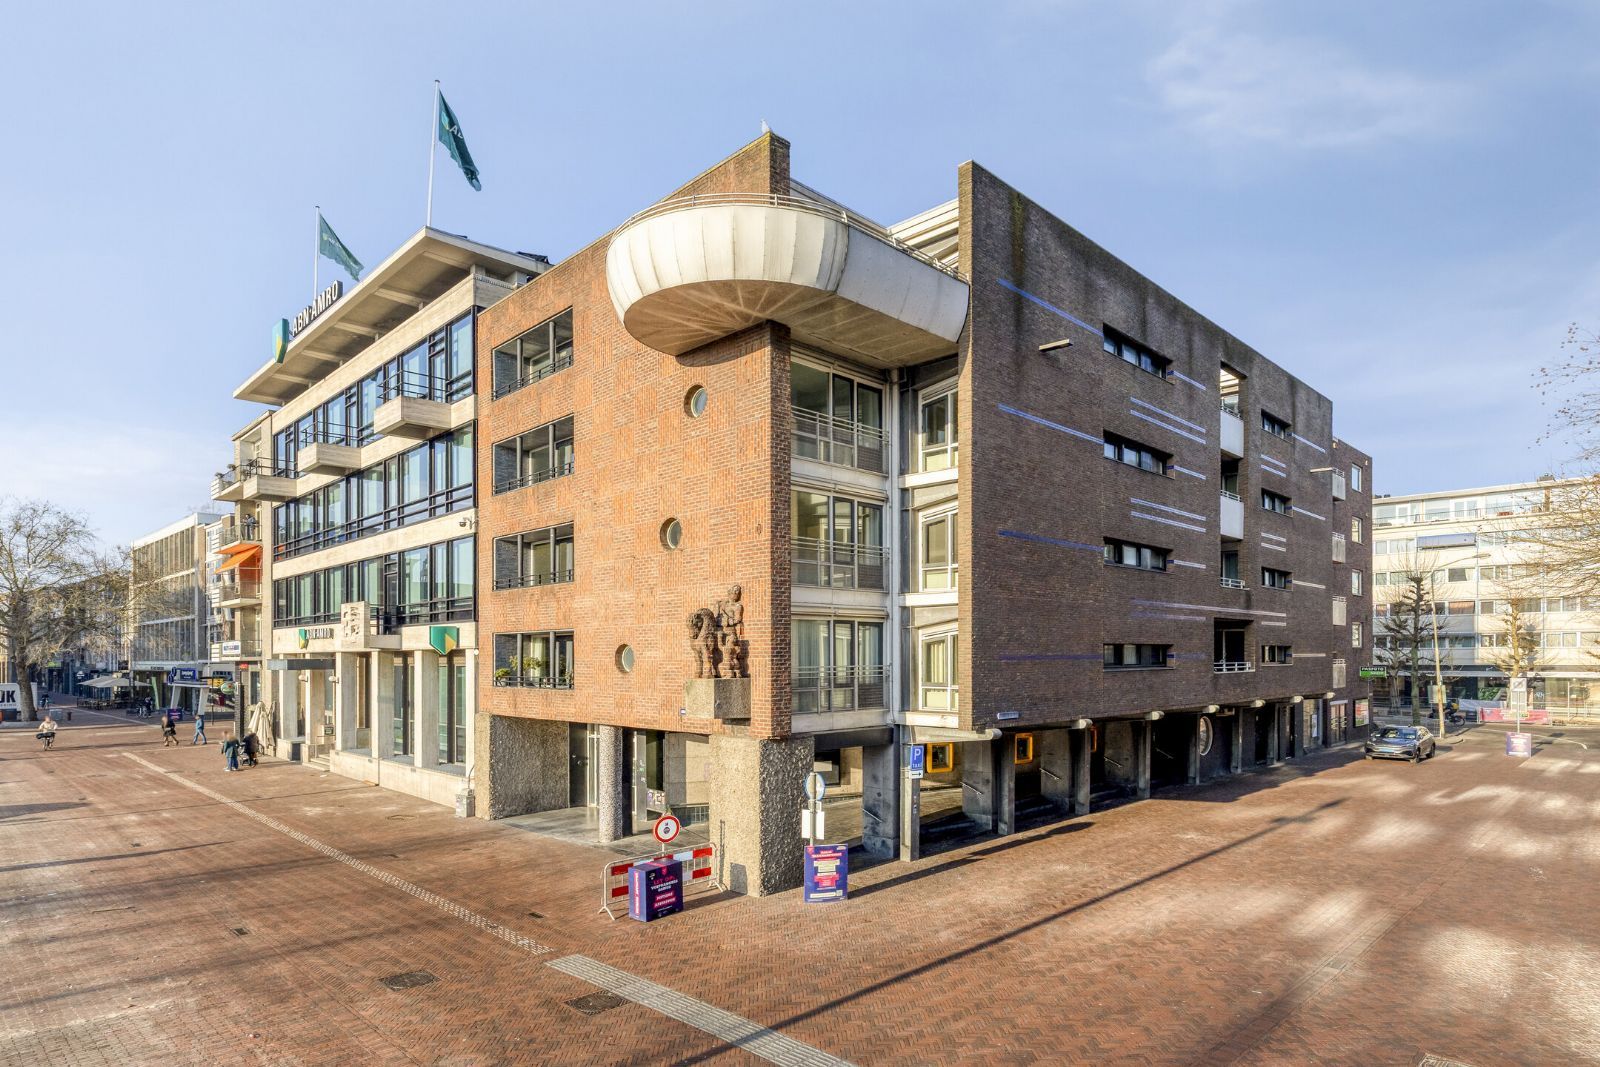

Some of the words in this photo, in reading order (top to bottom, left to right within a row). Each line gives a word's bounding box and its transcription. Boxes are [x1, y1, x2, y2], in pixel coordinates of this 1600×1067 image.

[292, 306, 310, 337] ABN
[311, 280, 340, 320] AMRO
[914, 748, 921, 760] P
